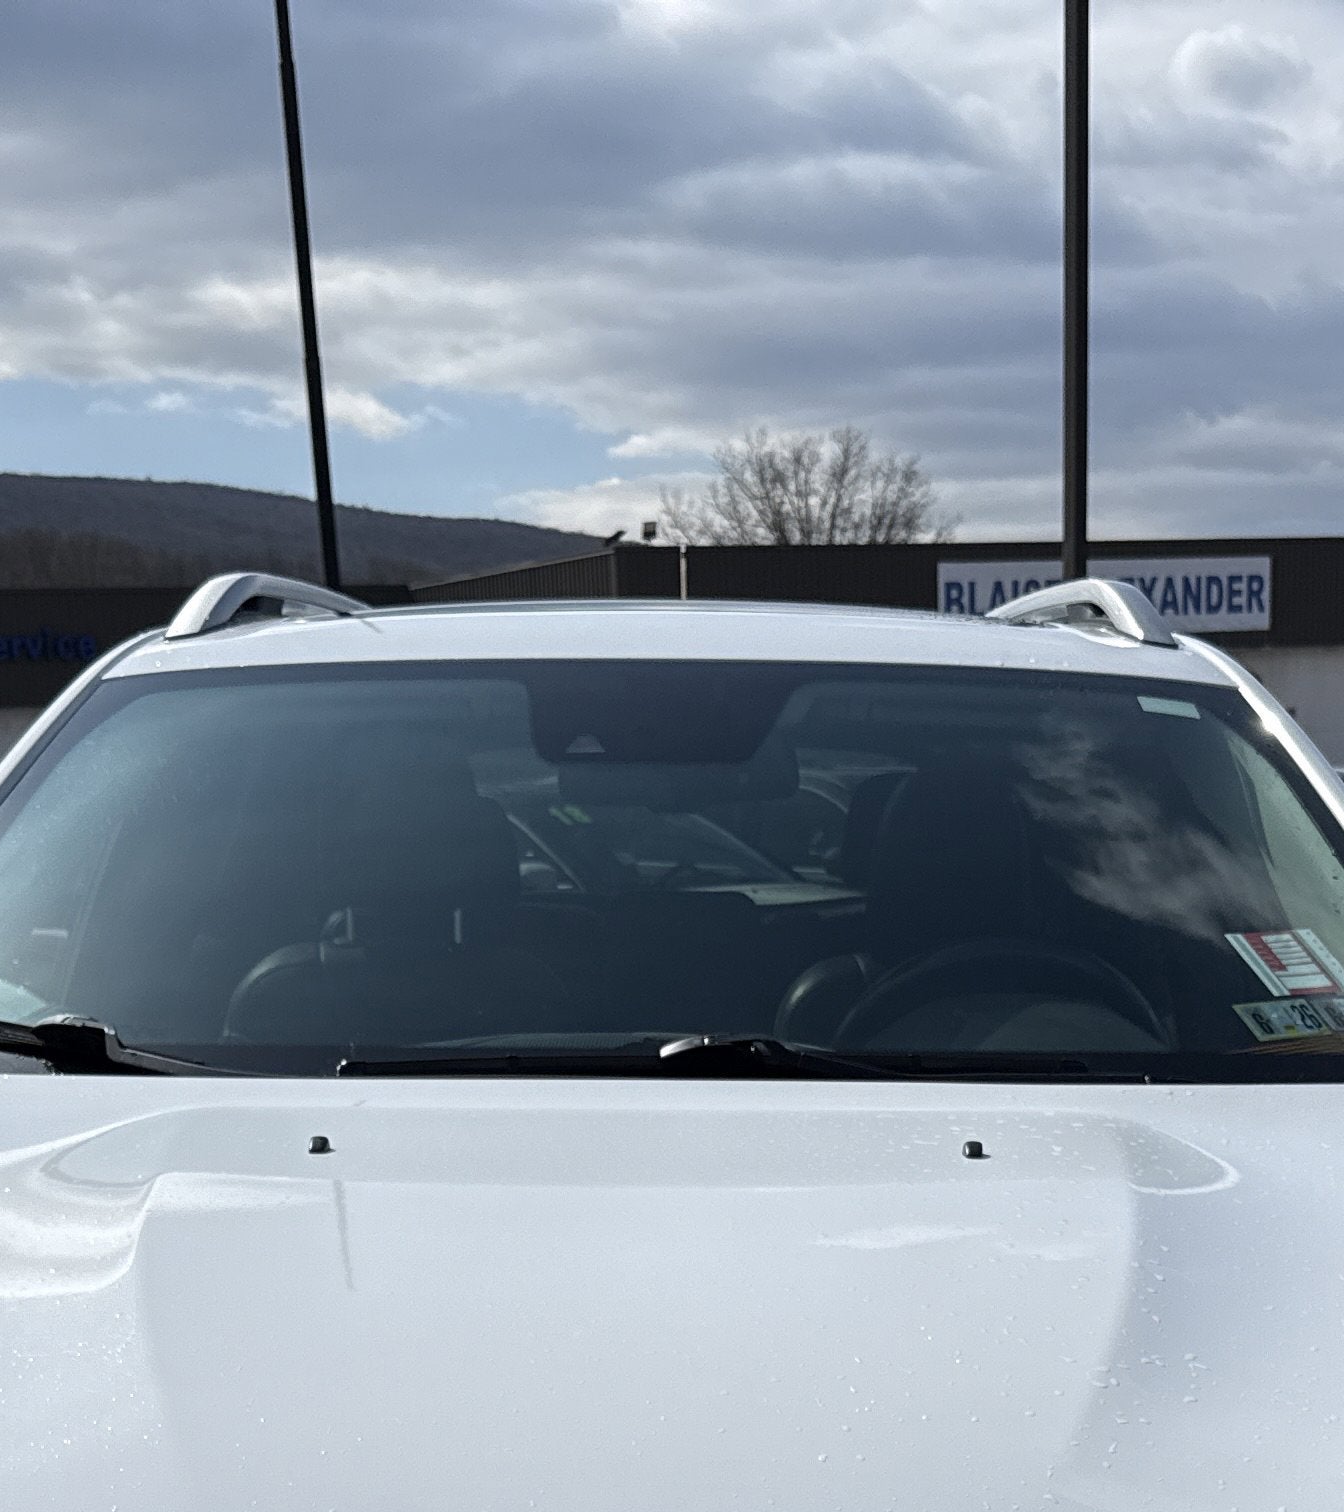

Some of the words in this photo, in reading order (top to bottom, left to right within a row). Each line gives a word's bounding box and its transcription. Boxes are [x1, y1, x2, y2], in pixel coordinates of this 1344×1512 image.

[943, 579, 1062, 616] BLAI
[1120, 574, 1266, 616] XANDER
[1290, 1004, 1323, 1030] 26
